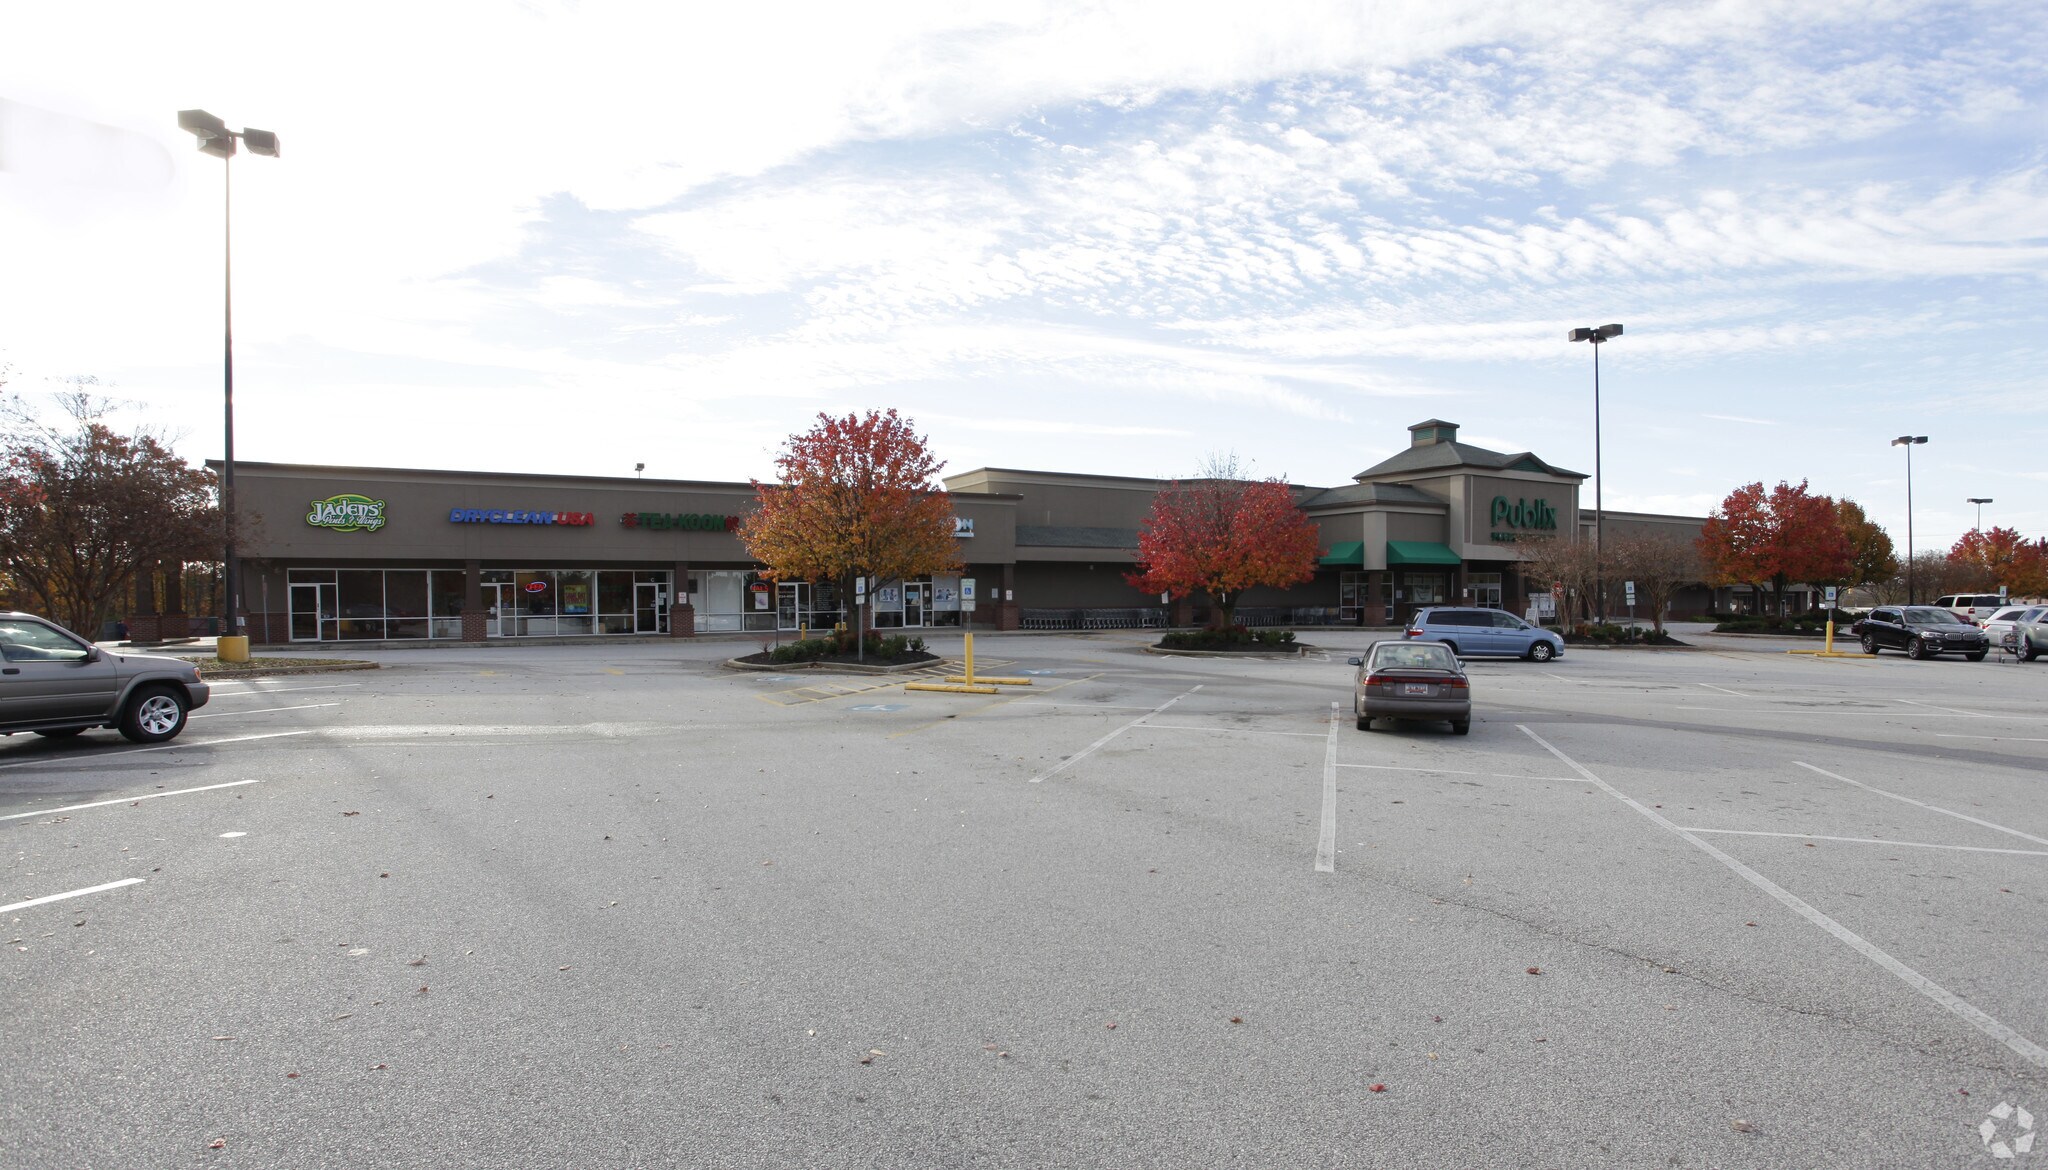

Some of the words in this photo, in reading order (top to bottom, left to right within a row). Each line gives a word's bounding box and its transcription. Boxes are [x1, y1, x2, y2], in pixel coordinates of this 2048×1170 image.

[450, 508, 554, 525] DRYCLEAN
[557, 511, 594, 527] USA
[1491, 495, 1558, 530] Publix
[357, 516, 383, 529] Wings
[525, 583, 545, 592] OPEN
